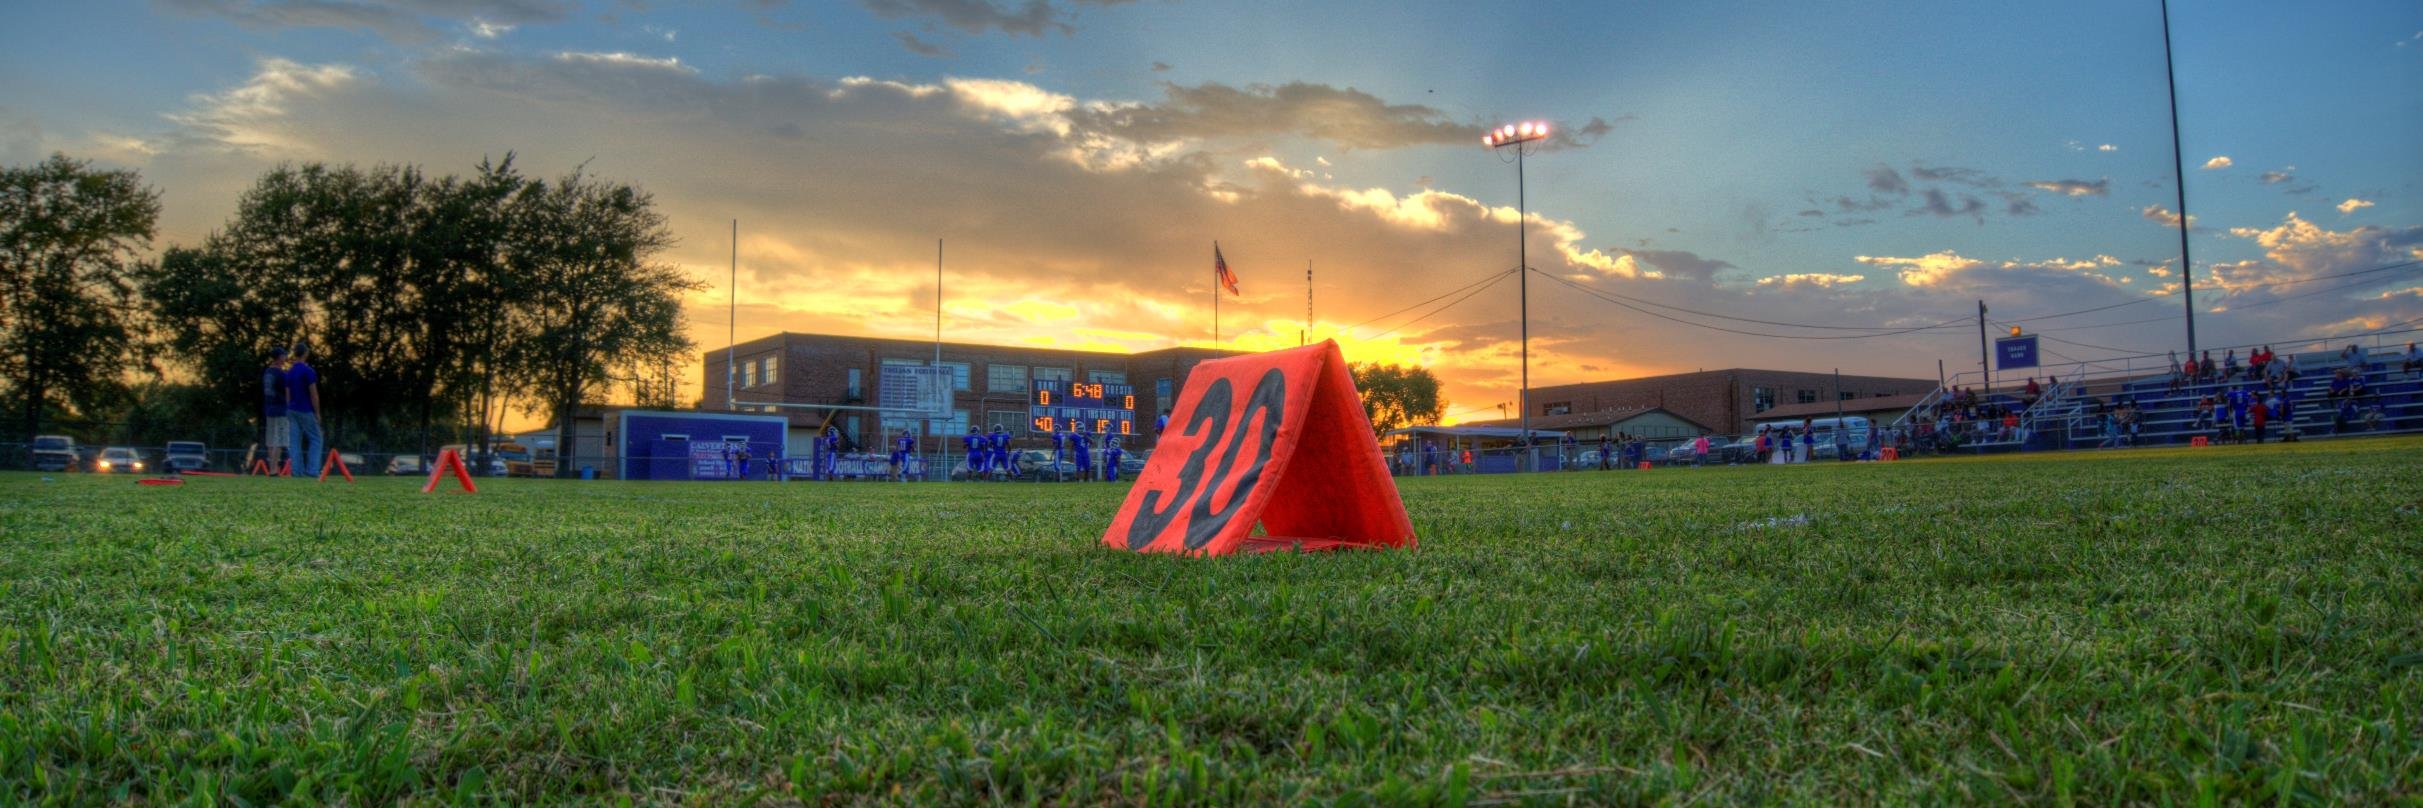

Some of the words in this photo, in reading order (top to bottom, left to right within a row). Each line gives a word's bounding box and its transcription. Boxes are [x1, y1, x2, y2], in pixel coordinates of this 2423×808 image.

[884, 367, 912, 375] TROJAN
[1040, 390, 1049, 405] 0
[1073, 383, 1103, 399] 6:48
[1125, 395, 1134, 410] 0
[1035, 417, 1053, 432] 40
[1121, 420, 1130, 435] 0
[1127, 367, 1286, 551] 30
